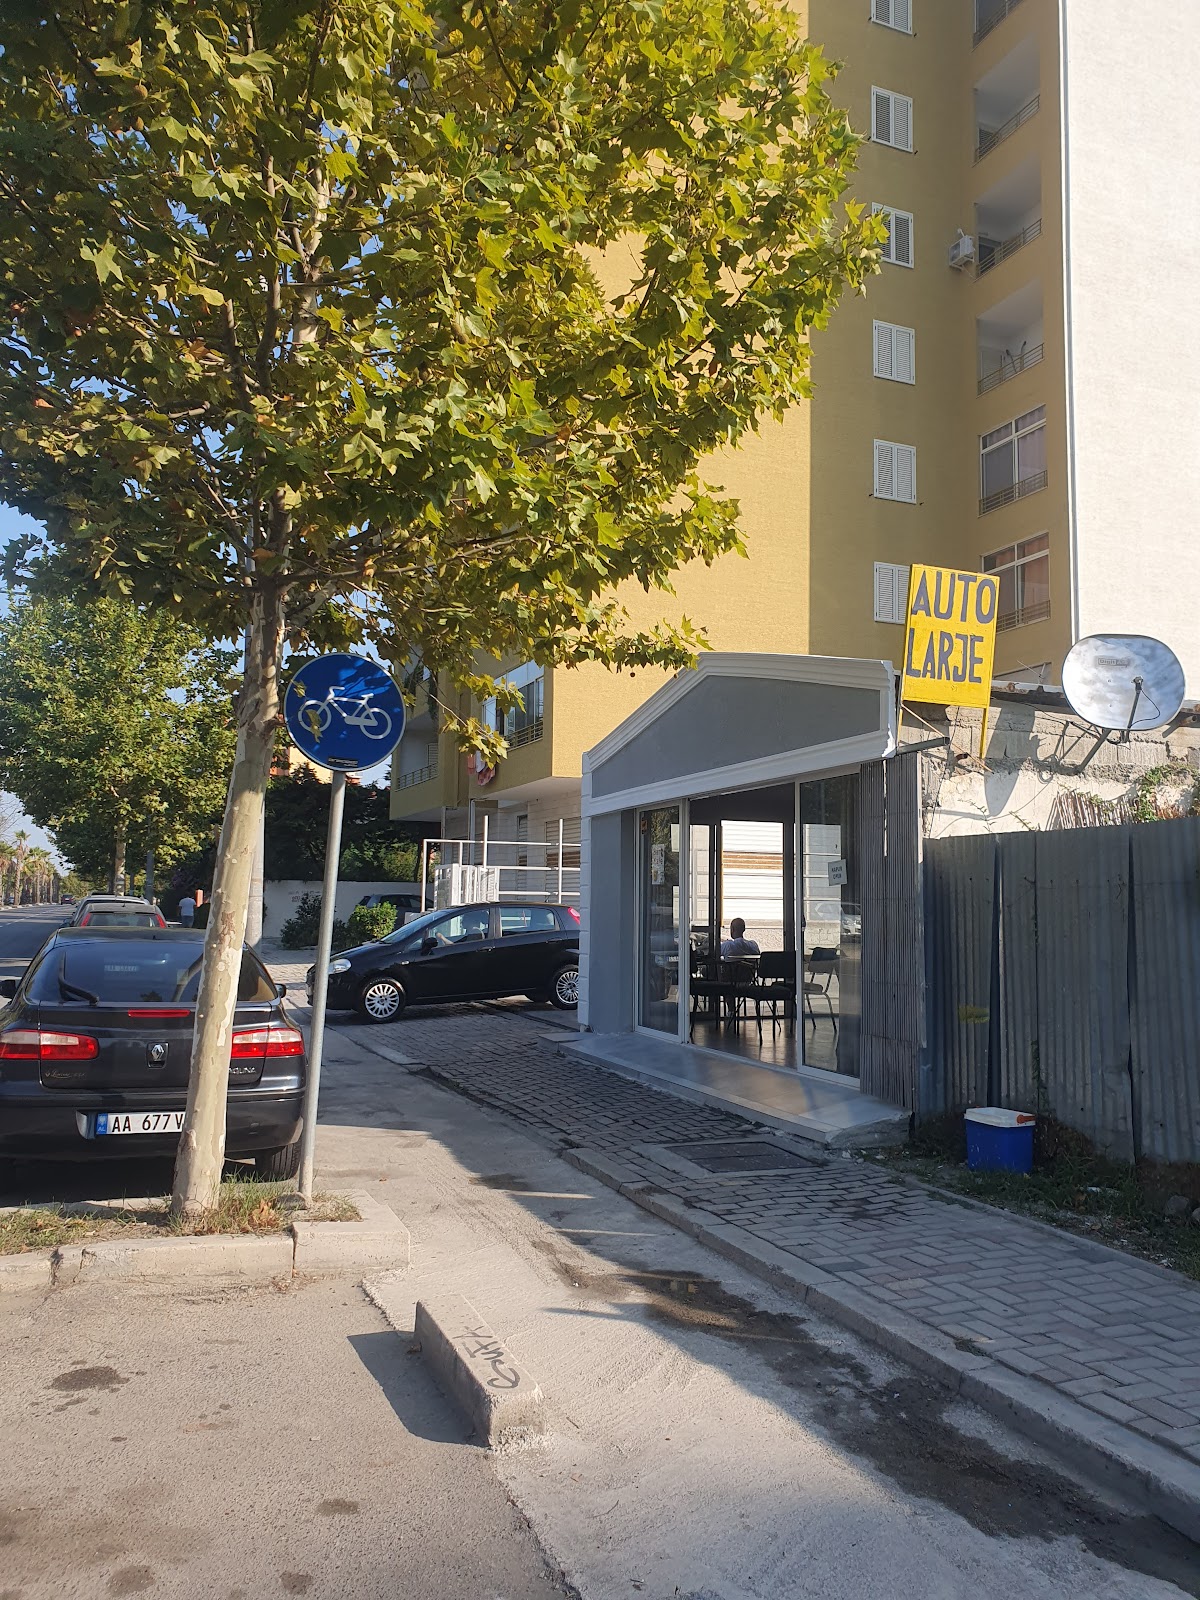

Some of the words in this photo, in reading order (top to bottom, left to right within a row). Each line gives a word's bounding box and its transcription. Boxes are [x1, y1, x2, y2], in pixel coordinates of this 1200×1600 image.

[911, 570, 996, 625] AUTO
[905, 627, 984, 684] LARJE
[111, 1115, 132, 1133] AA
[142, 1113, 171, 1131] 677
